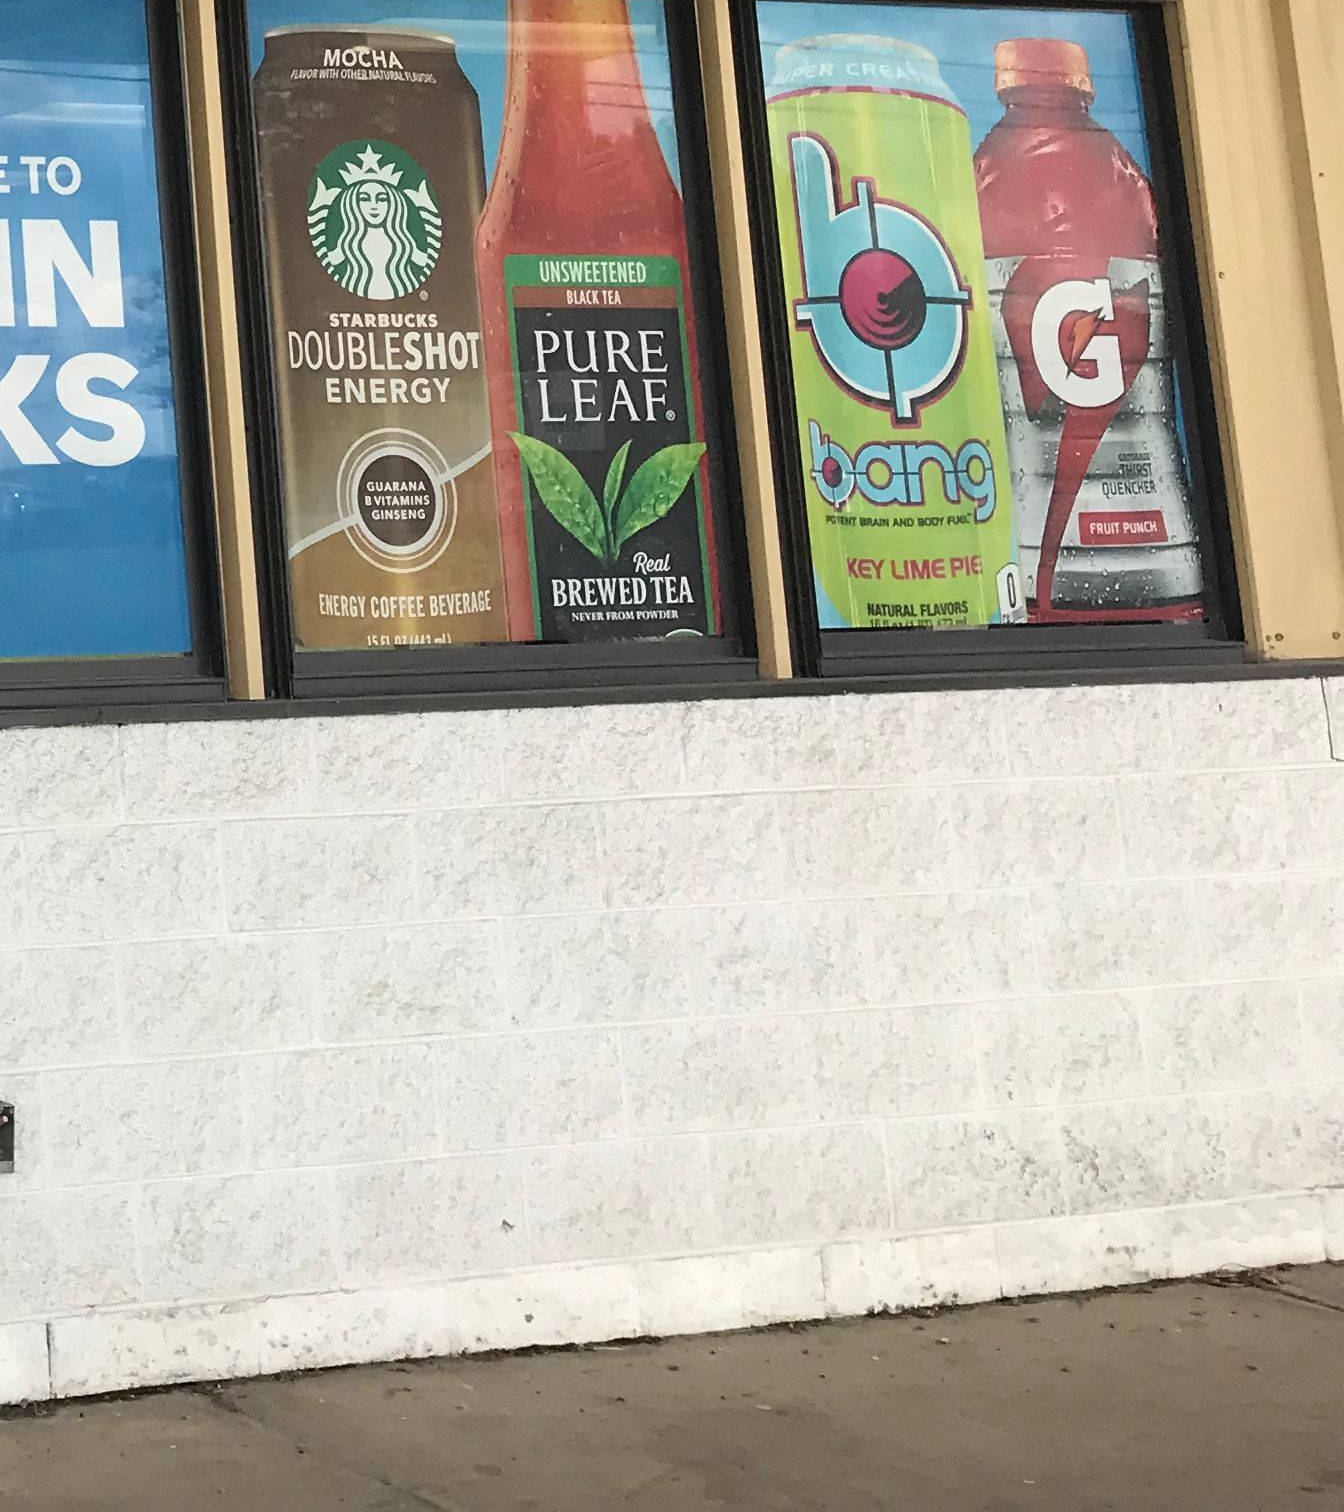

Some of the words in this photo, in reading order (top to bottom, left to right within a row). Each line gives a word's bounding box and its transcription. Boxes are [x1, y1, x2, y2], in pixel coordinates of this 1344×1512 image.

[323, 48, 404, 70] MOCHA
[319, 68, 339, 80] WITH
[340, 68, 369, 81] OTHER
[20, 155, 82, 196] TO
[539, 260, 647, 283] UNSWEETENED
[566, 289, 600, 305] BLACK
[602, 289, 622, 305] TEA
[329, 313, 438, 328] STARBUCKS
[288, 330, 479, 371] DOUBLESHOT
[534, 330, 669, 373] PURE
[1031, 278, 1126, 409] G
[325, 377, 451, 404] ENERGY
[537, 379, 668, 422] LEAF
[808, 418, 997, 525] bang
[1119, 462, 1152, 478] THIRST
[366, 481, 426, 492] GUARANA
[1102, 480, 1157, 499] QUENCHER
[364, 495, 372, 506] B
[373, 495, 430, 506] VITAMINS
[372, 509, 426, 520] GINSENG
[826, 515, 857, 526] POTENT
[859, 516, 890, 527] BRAIN
[893, 517, 915, 528] AND
[918, 515, 944, 527] BODY
[1089, 522, 1120, 535] FRUIT
[1123, 520, 1158, 534] PUNCH
[633, 551, 671, 575] Real
[847, 557, 885, 580] KEY
[890, 557, 946, 580] LIME
[949, 555, 983, 578] PIE
[551, 577, 647, 607] BREWED
[650, 576, 695, 604] TEA
[318, 593, 366, 618] ENERGY
[370, 595, 426, 619] COFFEE
[429, 589, 492, 617] BEVERAGE
[572, 612, 605, 621] NEVER
[606, 611, 634, 621] FROM
[636, 609, 679, 620] POWDER
[867, 603, 917, 618] NATURAL
[919, 600, 969, 617] FLAVORS
